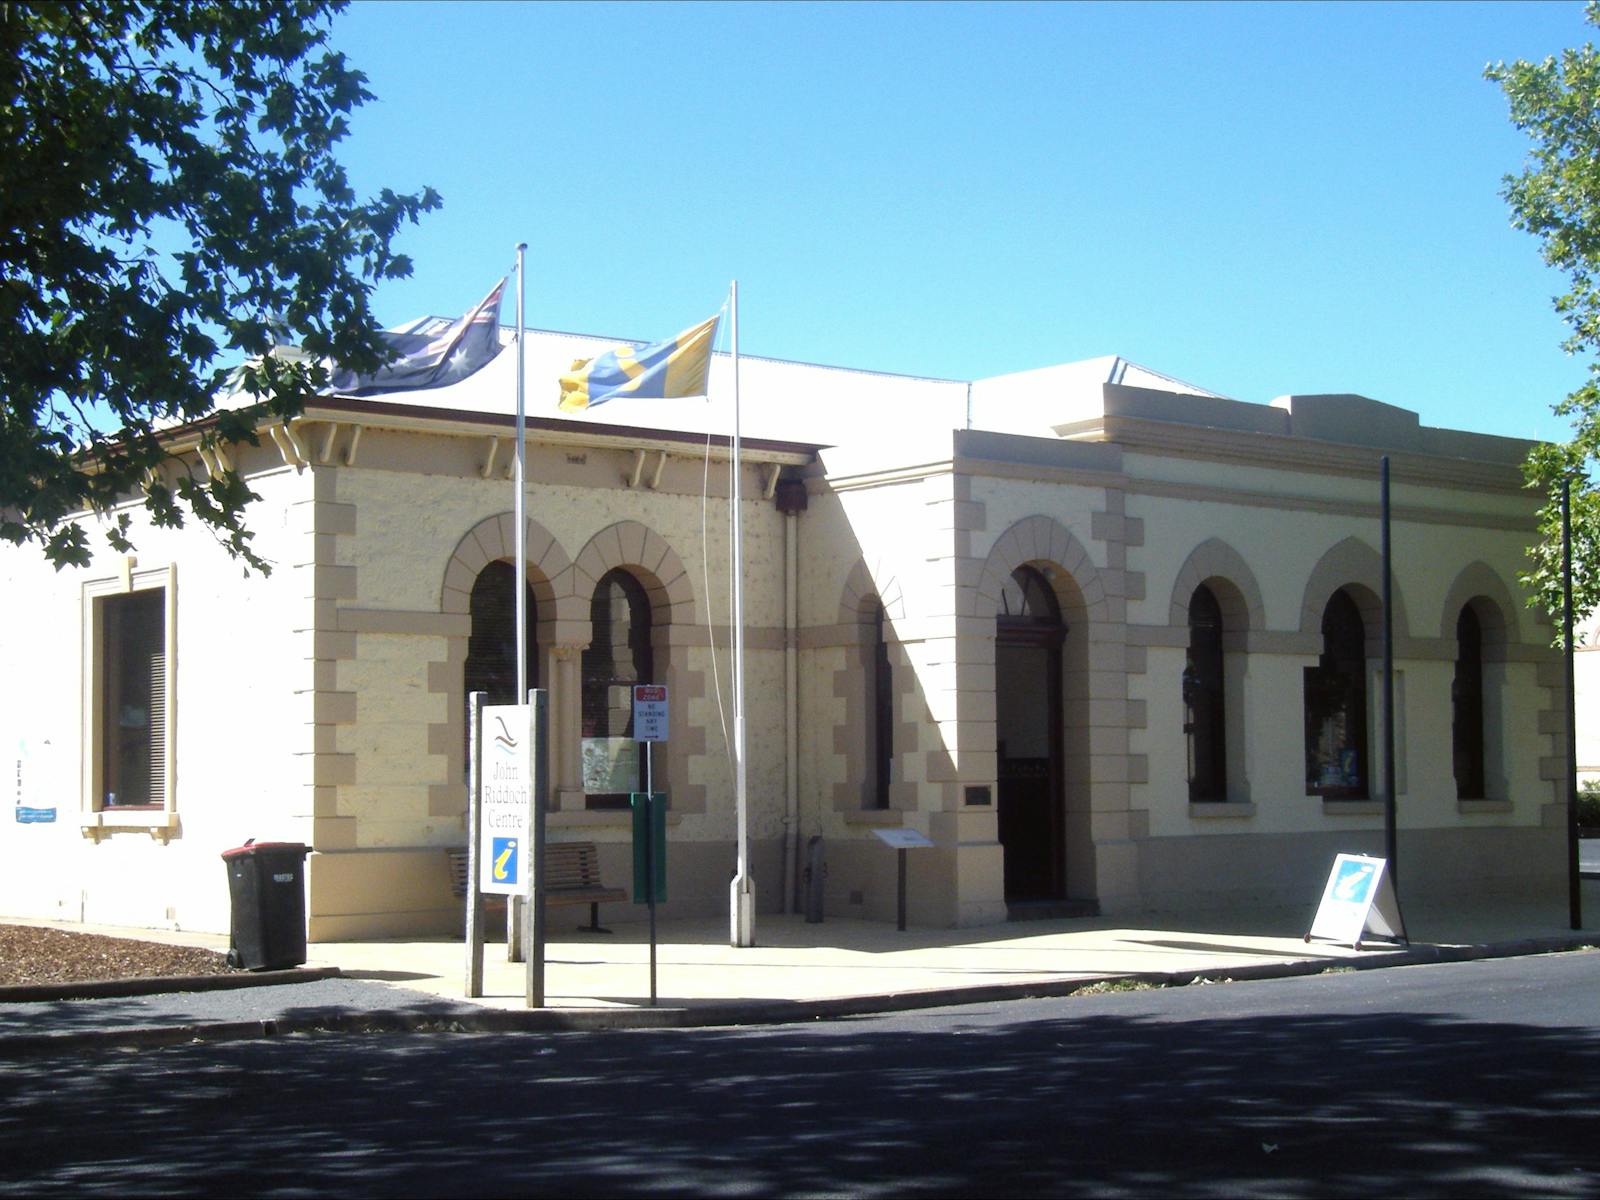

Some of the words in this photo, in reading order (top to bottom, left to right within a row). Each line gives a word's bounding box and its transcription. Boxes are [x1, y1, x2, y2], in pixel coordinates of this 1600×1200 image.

[493, 762, 518, 780] John
[485, 785, 527, 804] Riddoch
[488, 810, 522, 828] Centre
